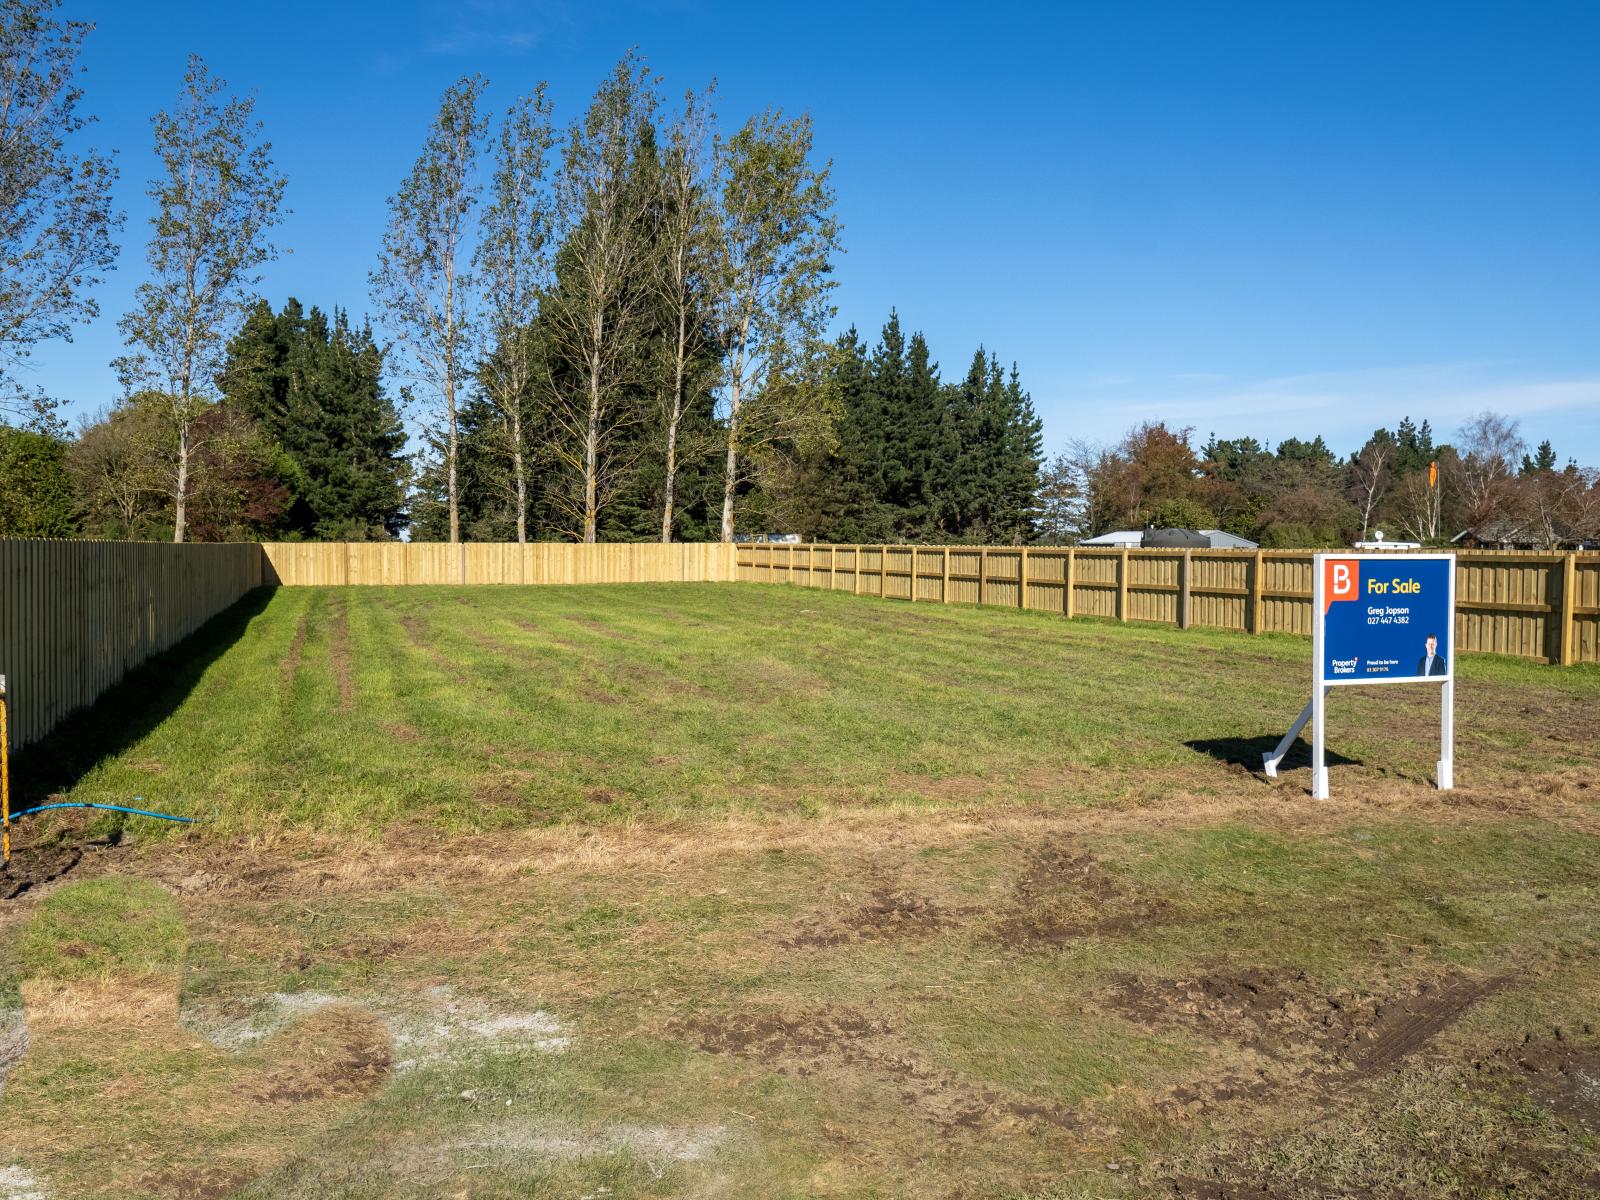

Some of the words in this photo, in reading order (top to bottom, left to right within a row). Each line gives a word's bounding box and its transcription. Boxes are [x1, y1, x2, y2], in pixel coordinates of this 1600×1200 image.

[1334, 565, 1350, 594] B
[1368, 579, 1389, 594] For
[1392, 578, 1420, 593] Sale
[1367, 606, 1384, 616] Greg
[1386, 606, 1409, 616] Jopson
[1394, 616, 1409, 624] 4382
[1332, 660, 1356, 668] Property
